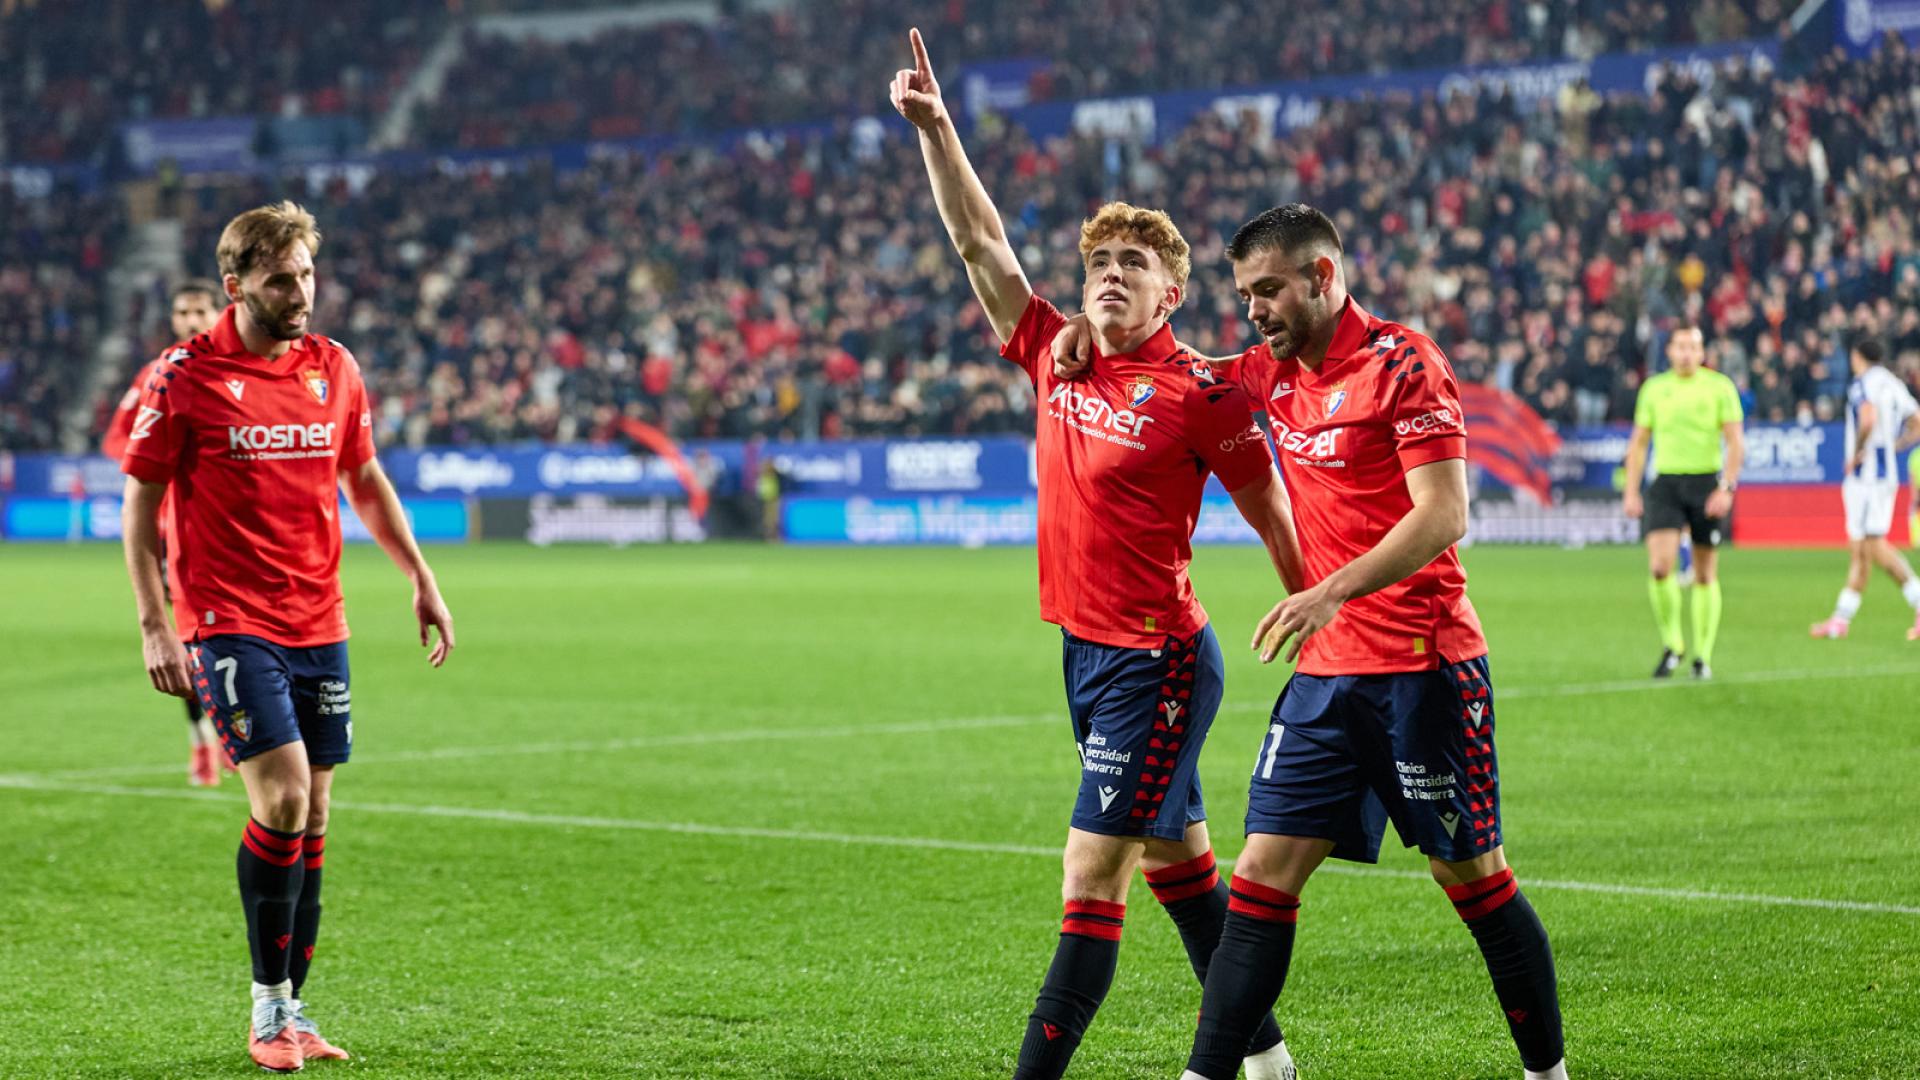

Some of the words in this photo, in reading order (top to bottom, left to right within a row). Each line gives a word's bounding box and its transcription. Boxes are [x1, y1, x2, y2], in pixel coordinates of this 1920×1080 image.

[1107, 434, 1146, 451] eficiente
[214, 656, 238, 706] 7
[1399, 772, 1456, 787] Universidad
[1413, 788, 1455, 800] Navarra
